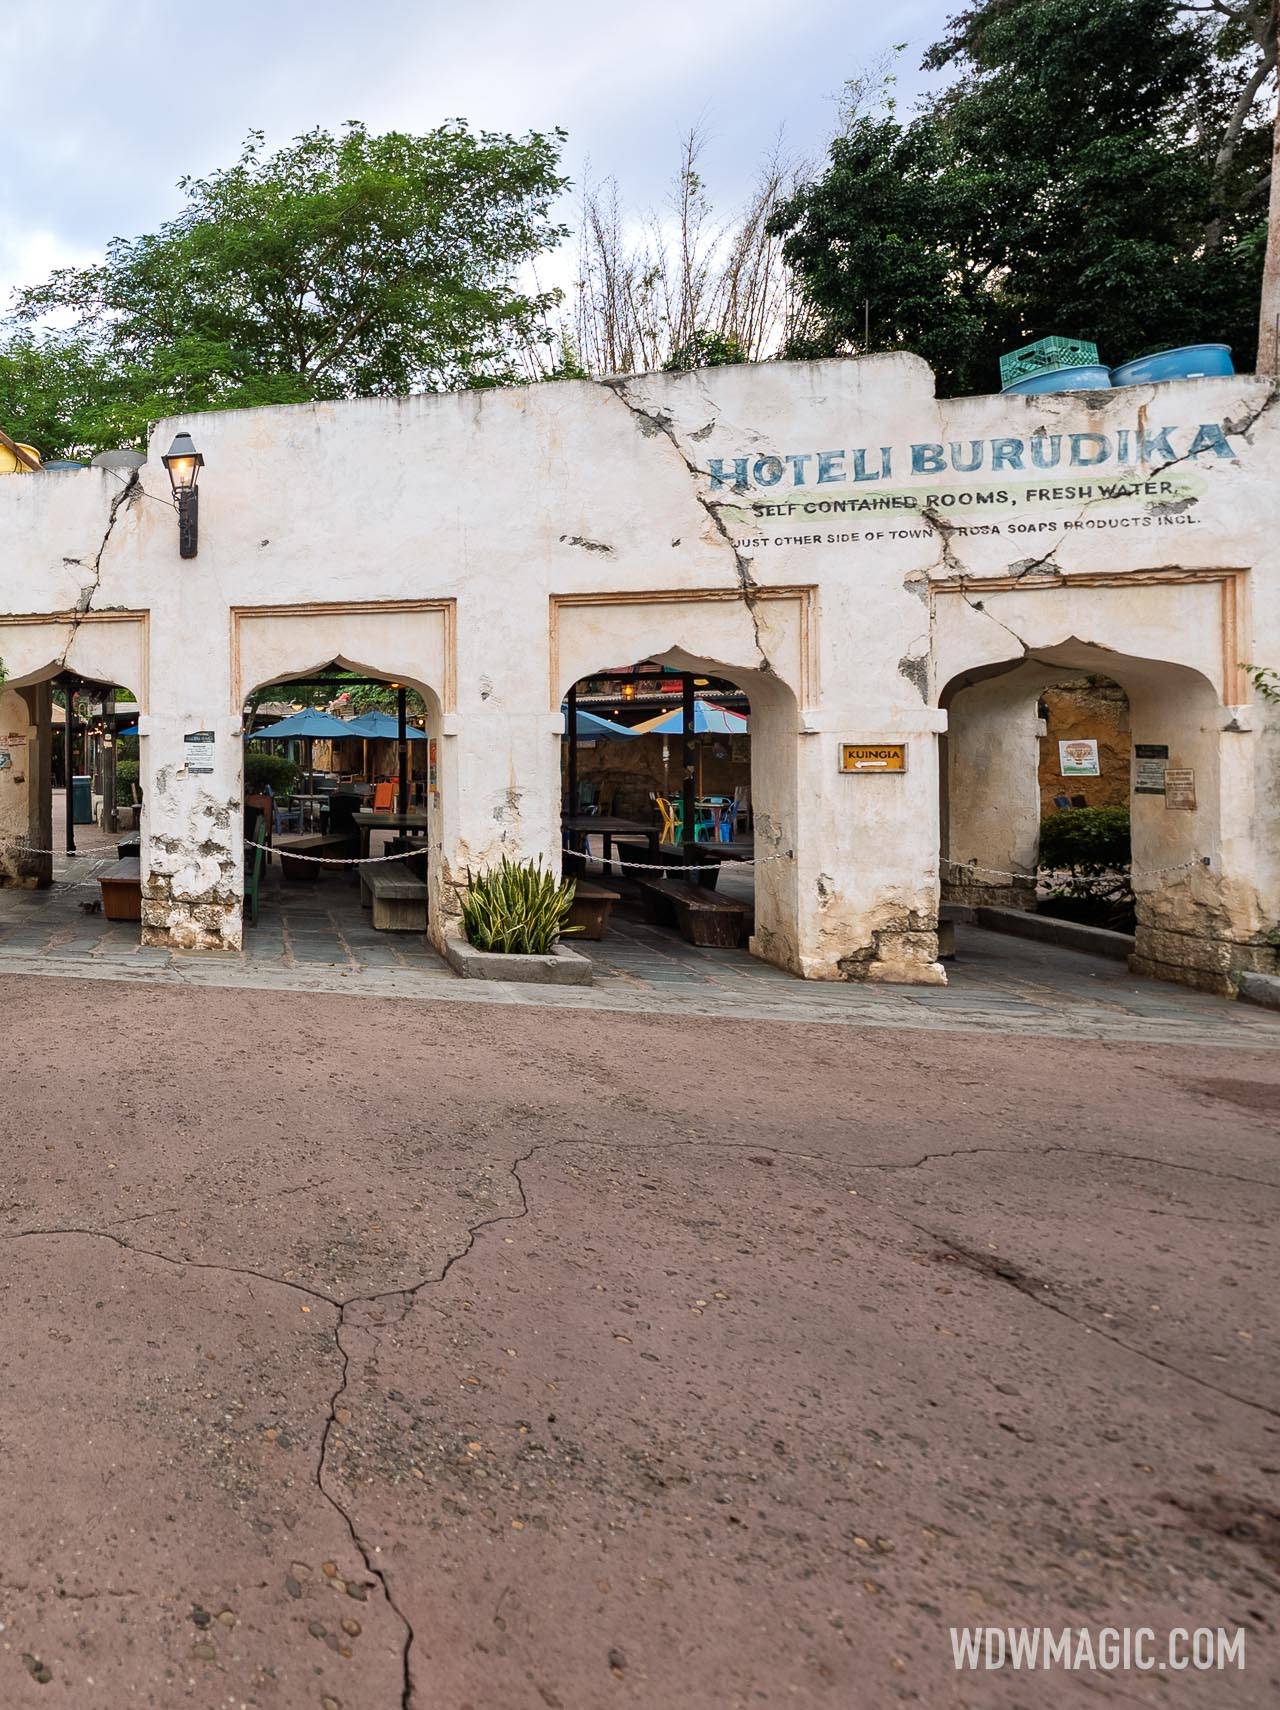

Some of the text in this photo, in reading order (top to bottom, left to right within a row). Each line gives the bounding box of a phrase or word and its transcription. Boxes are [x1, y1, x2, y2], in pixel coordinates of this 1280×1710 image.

[708, 422, 1237, 490] HOTELI BURUDIKA
[753, 503, 796, 517] SELF
[803, 495, 918, 514] CONTAINED
[925, 490, 1017, 508] ROOMS,
[1026, 485, 1092, 502] FRESH
[734, 538, 770, 549] JUST
[774, 534, 822, 547] OTHER
[827, 532, 860, 544] SIDE
[864, 531, 885, 541] OF
[889, 528, 934, 540] TOWN
[1007, 521, 1058, 534] SOAPS
[1063, 516, 1152, 531] PRODUCTS
[1157, 514, 1202, 526] INCL.
[848, 750, 900, 759] KUINGIA
